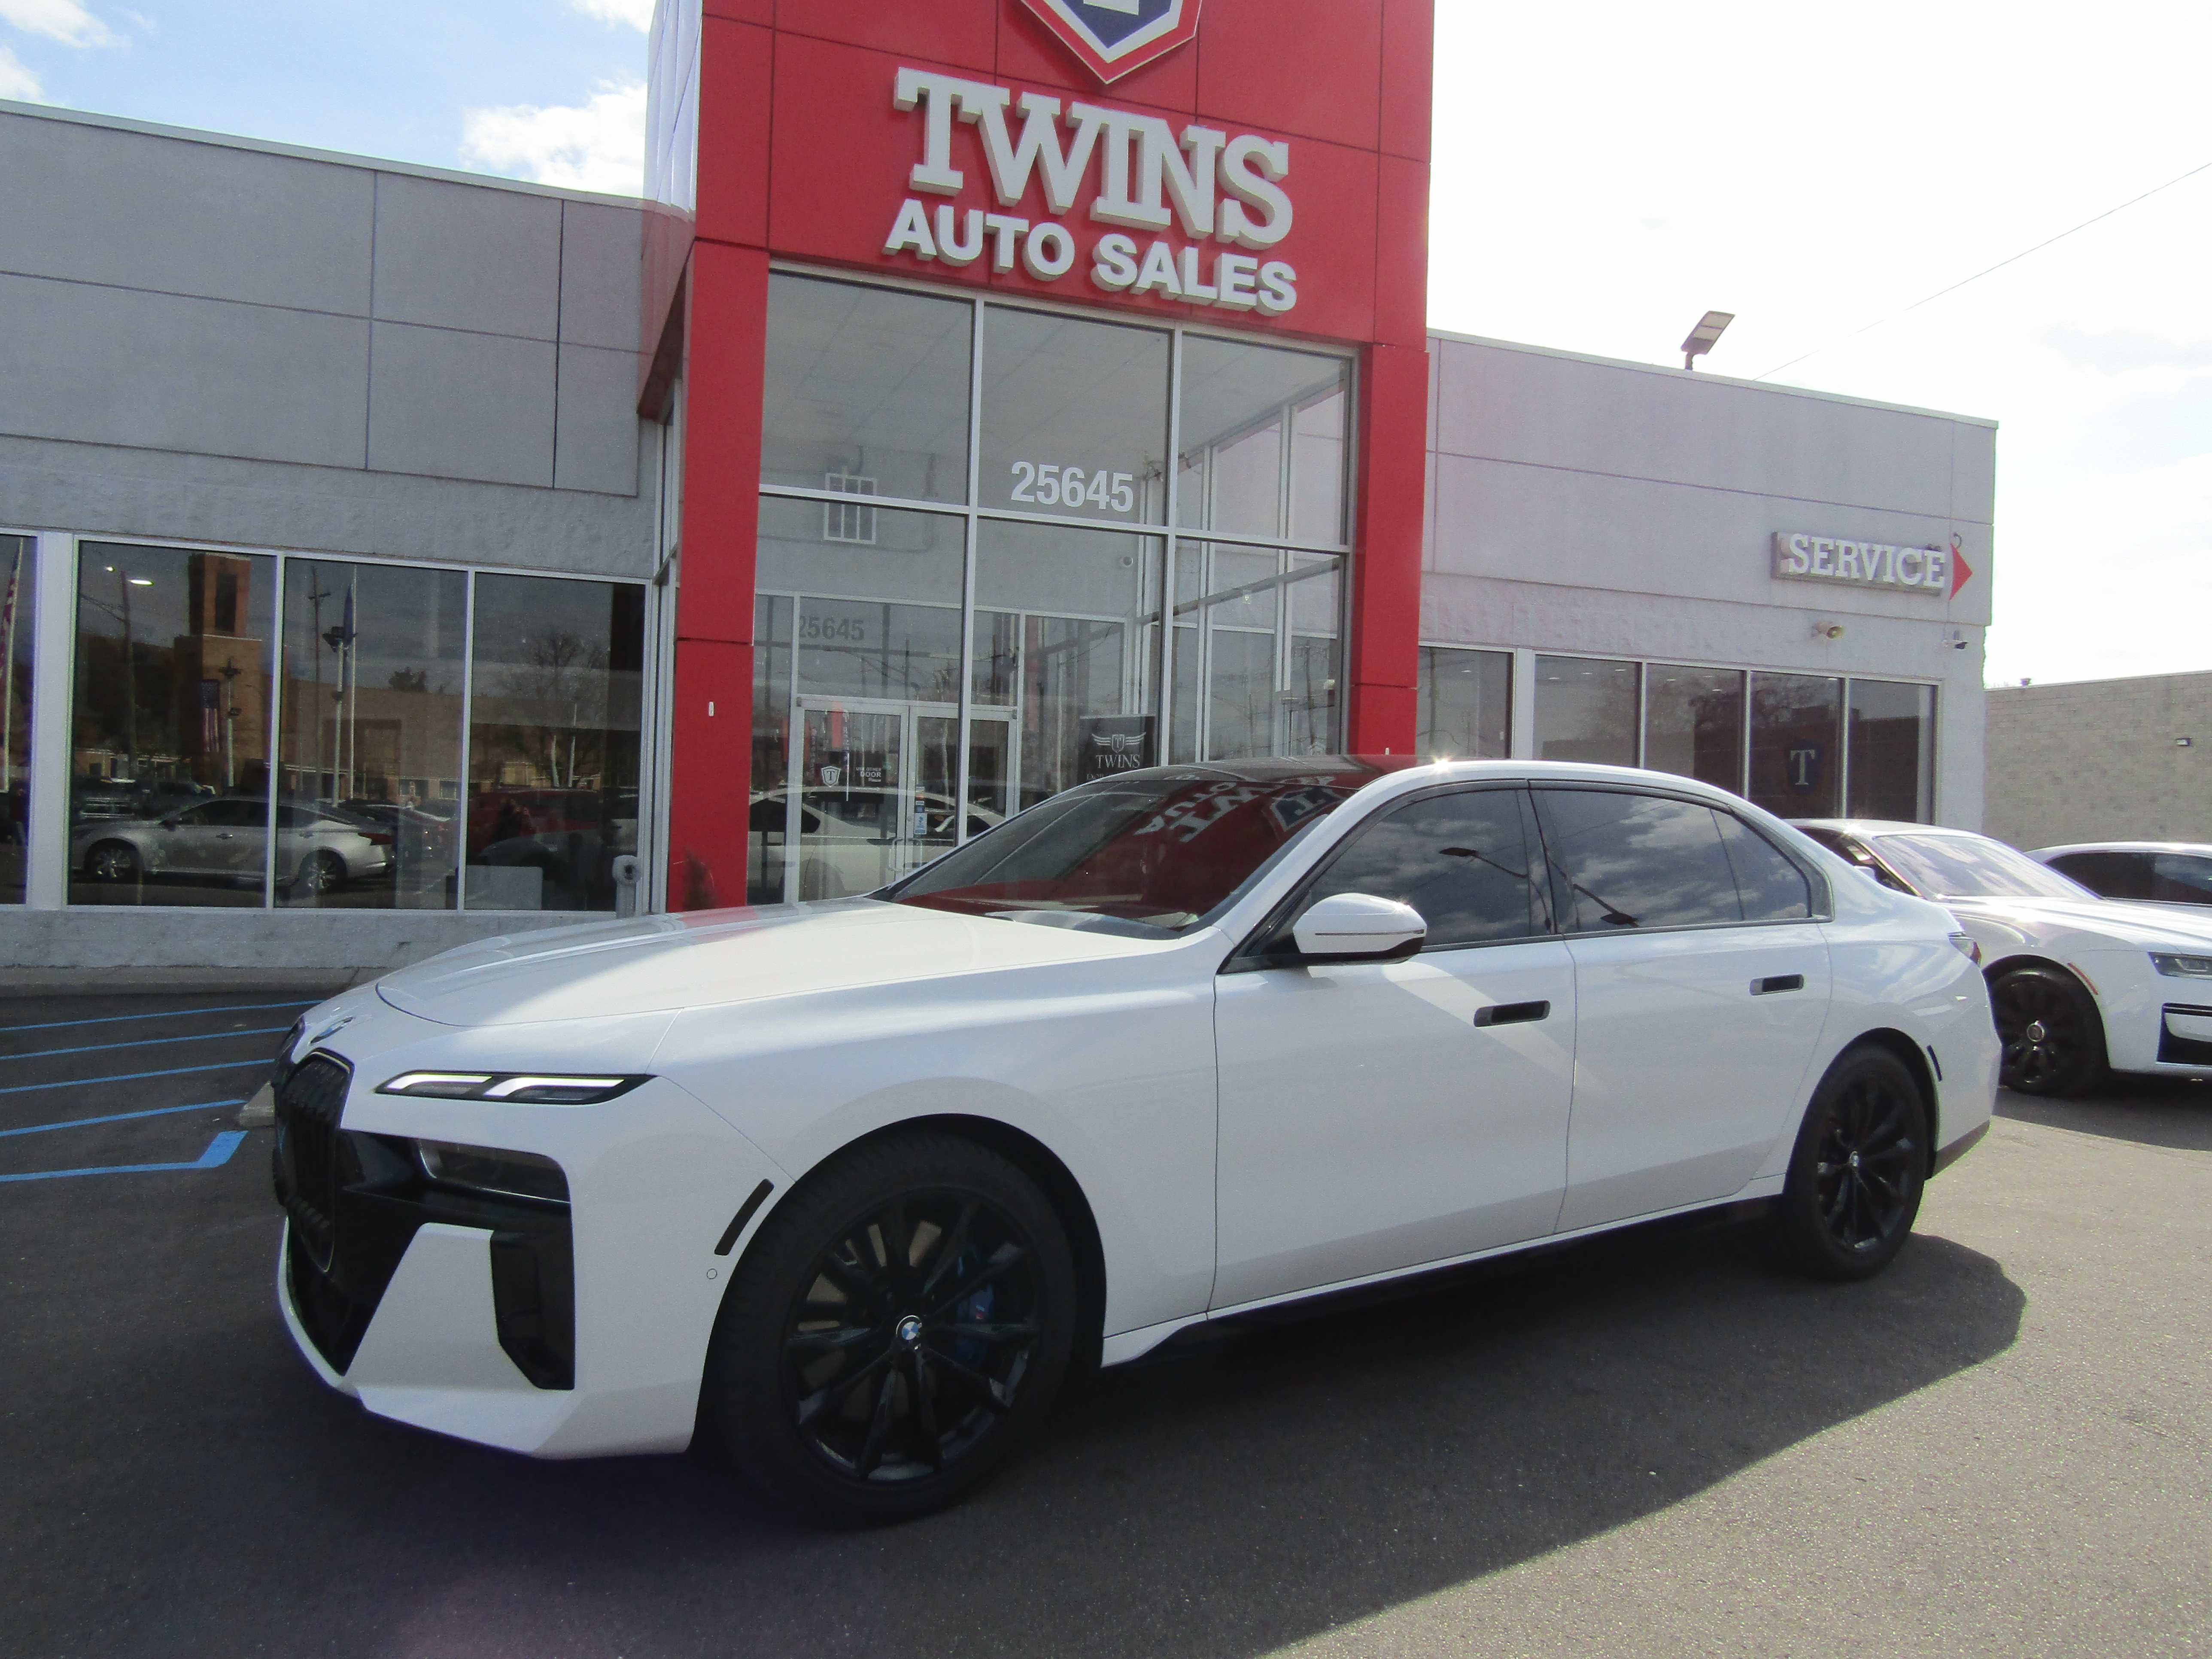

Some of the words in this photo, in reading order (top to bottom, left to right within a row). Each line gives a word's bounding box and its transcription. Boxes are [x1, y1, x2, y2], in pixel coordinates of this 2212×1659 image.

[893, 67, 1293, 250] TWINS
[883, 198, 1075, 281] AUTO
[1090, 233, 1297, 316] SALES
[1011, 461, 1133, 512] 25645
[1788, 533, 1945, 588] SERVICE
[1096, 754, 1140, 769] TWINS
[1790, 749, 1815, 785] T
